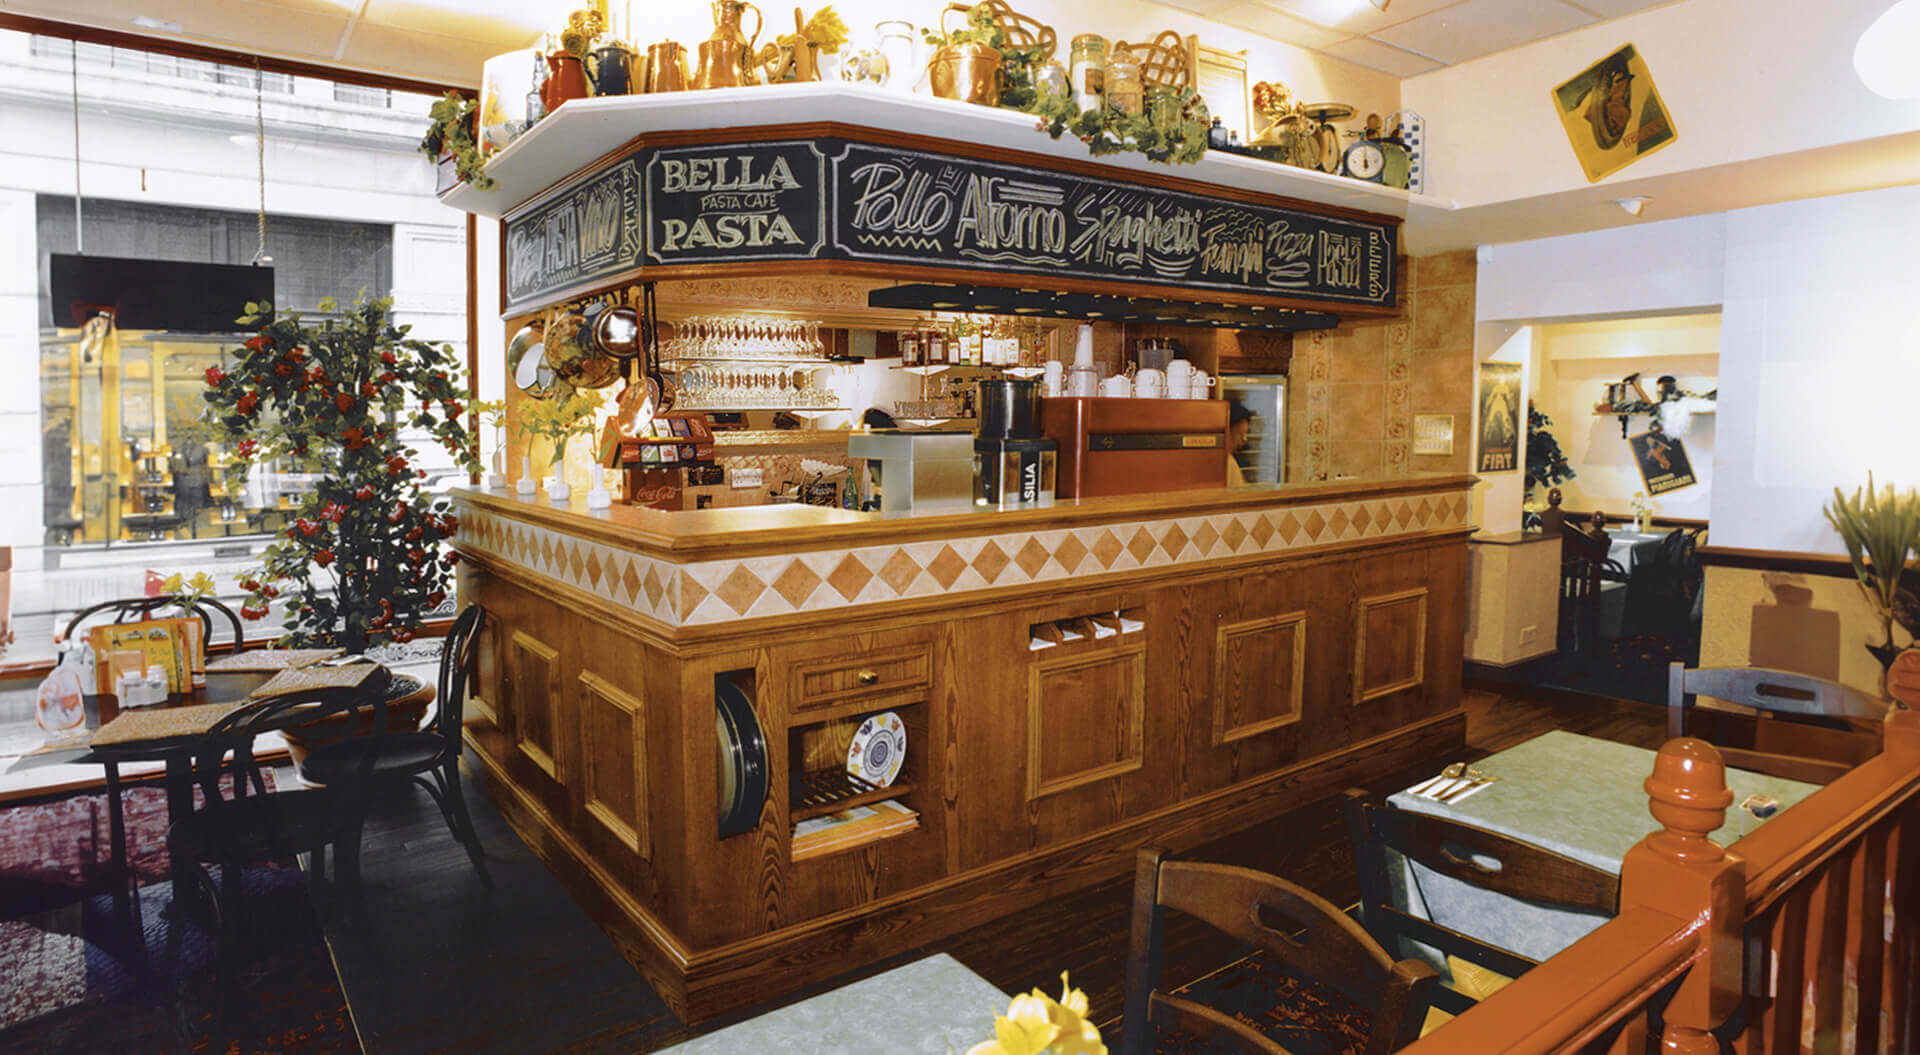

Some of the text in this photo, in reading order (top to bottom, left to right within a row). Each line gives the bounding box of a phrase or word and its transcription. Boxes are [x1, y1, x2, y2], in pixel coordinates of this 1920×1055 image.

[660, 154, 803, 193] BELLA
[701, 194, 742, 210] PASTA
[545, 205, 579, 275] PASTA
[661, 214, 805, 252] PASTA
[850, 162, 954, 235] Pollo
[1069, 189, 1201, 266] Spaghetti
[1199, 222, 1264, 284] Funghi
[1266, 220, 1316, 261] Pizza
[1317, 229, 1363, 291] Pasta
[1481, 453, 1513, 471] FIAT
